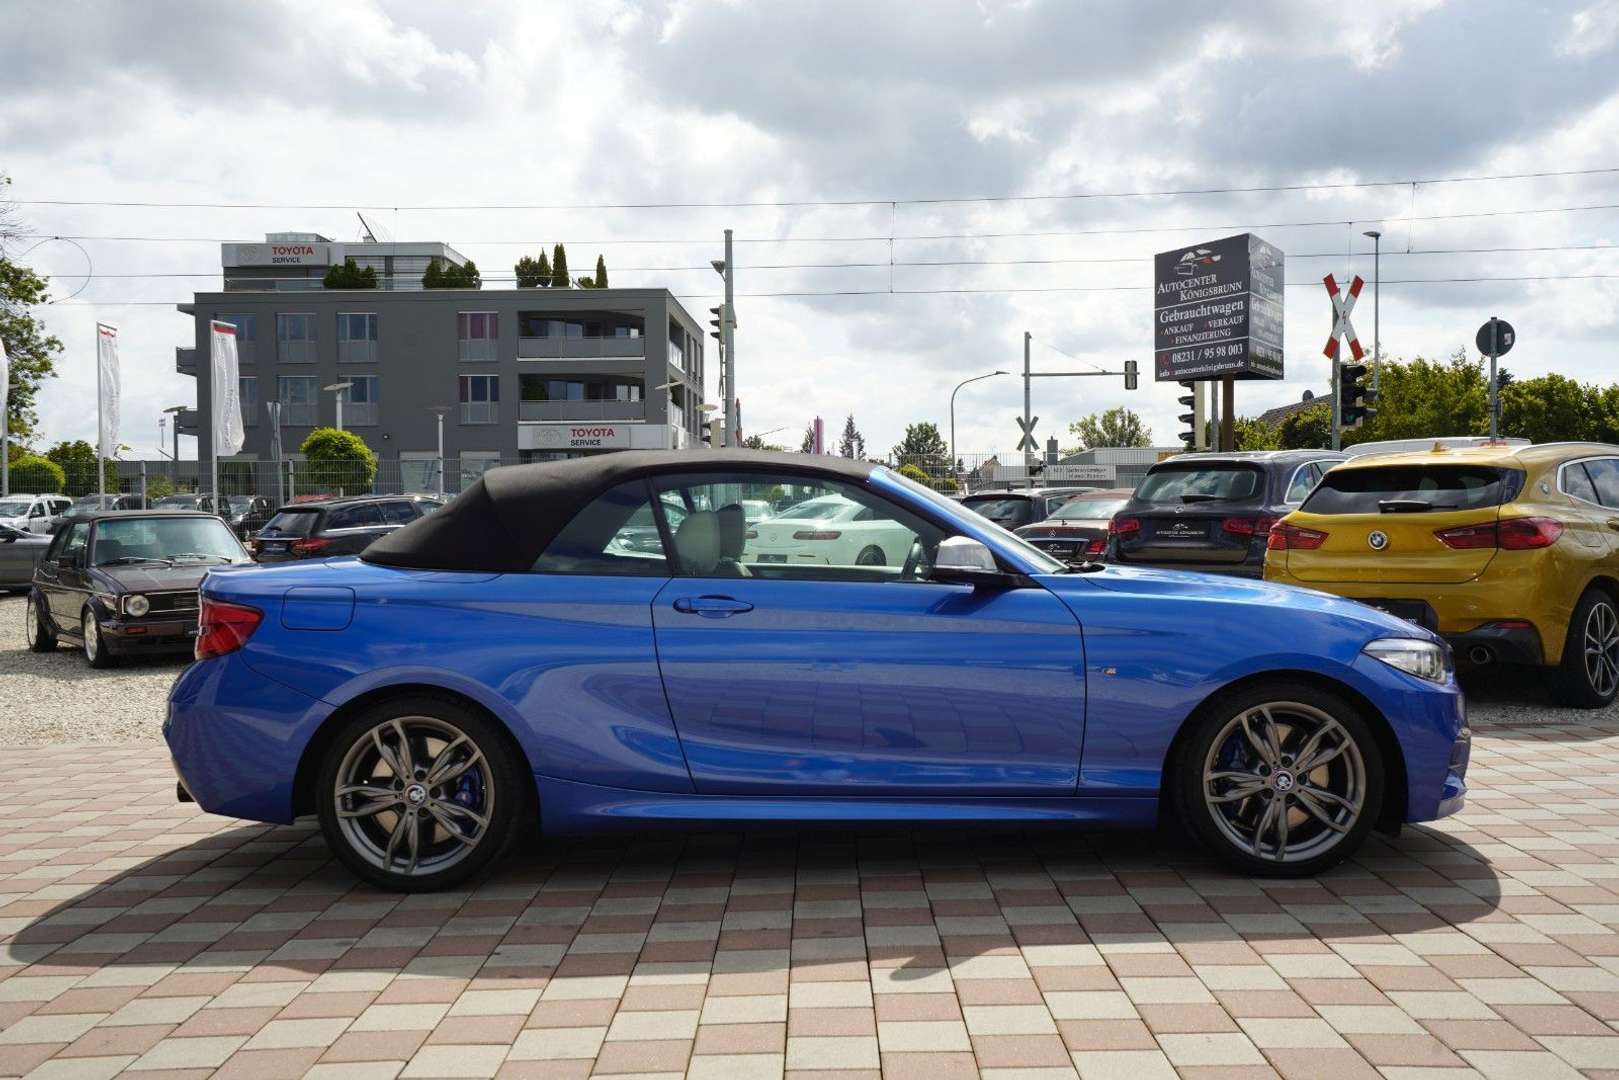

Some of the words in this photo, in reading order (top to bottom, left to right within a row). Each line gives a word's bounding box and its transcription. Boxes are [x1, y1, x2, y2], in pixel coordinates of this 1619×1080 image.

[271, 246, 314, 255] TOYOTA
[1157, 274, 1217, 295] AUTOCENTER
[1179, 281, 1242, 302] KÖNIGSBRUNN
[1160, 301, 1244, 324] Gebrauchtwagen
[1163, 322, 1195, 336] ANKAUF
[1208, 315, 1245, 329] VERKAUF
[1175, 328, 1232, 345] FINANZIERUNG
[1172, 350, 1195, 364] 08231
[1204, 347, 1215, 360] 95
[1216, 345, 1227, 358] 98
[1228, 343, 1243, 356] 003
[570, 439, 601, 447] SERVICE
[571, 428, 615, 438] TOYOTA
